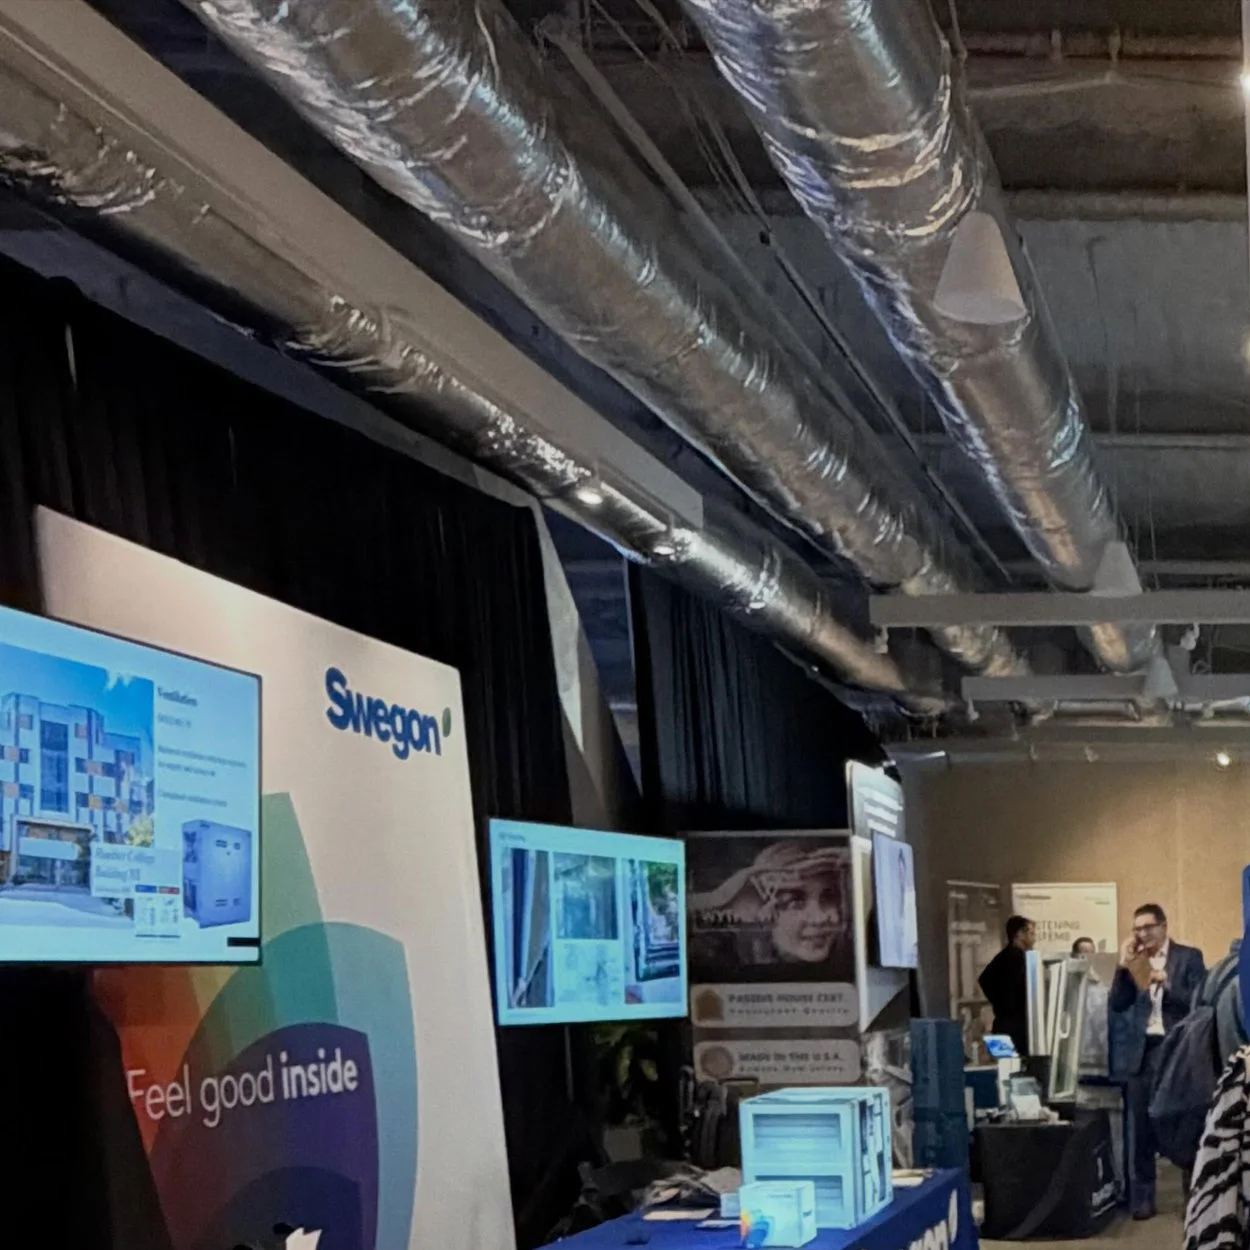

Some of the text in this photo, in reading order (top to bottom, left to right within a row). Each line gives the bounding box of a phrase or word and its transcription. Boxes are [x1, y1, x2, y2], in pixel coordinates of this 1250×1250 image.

[325, 667, 442, 760] Swegon
[126, 1047, 359, 1128] Feel good inside
